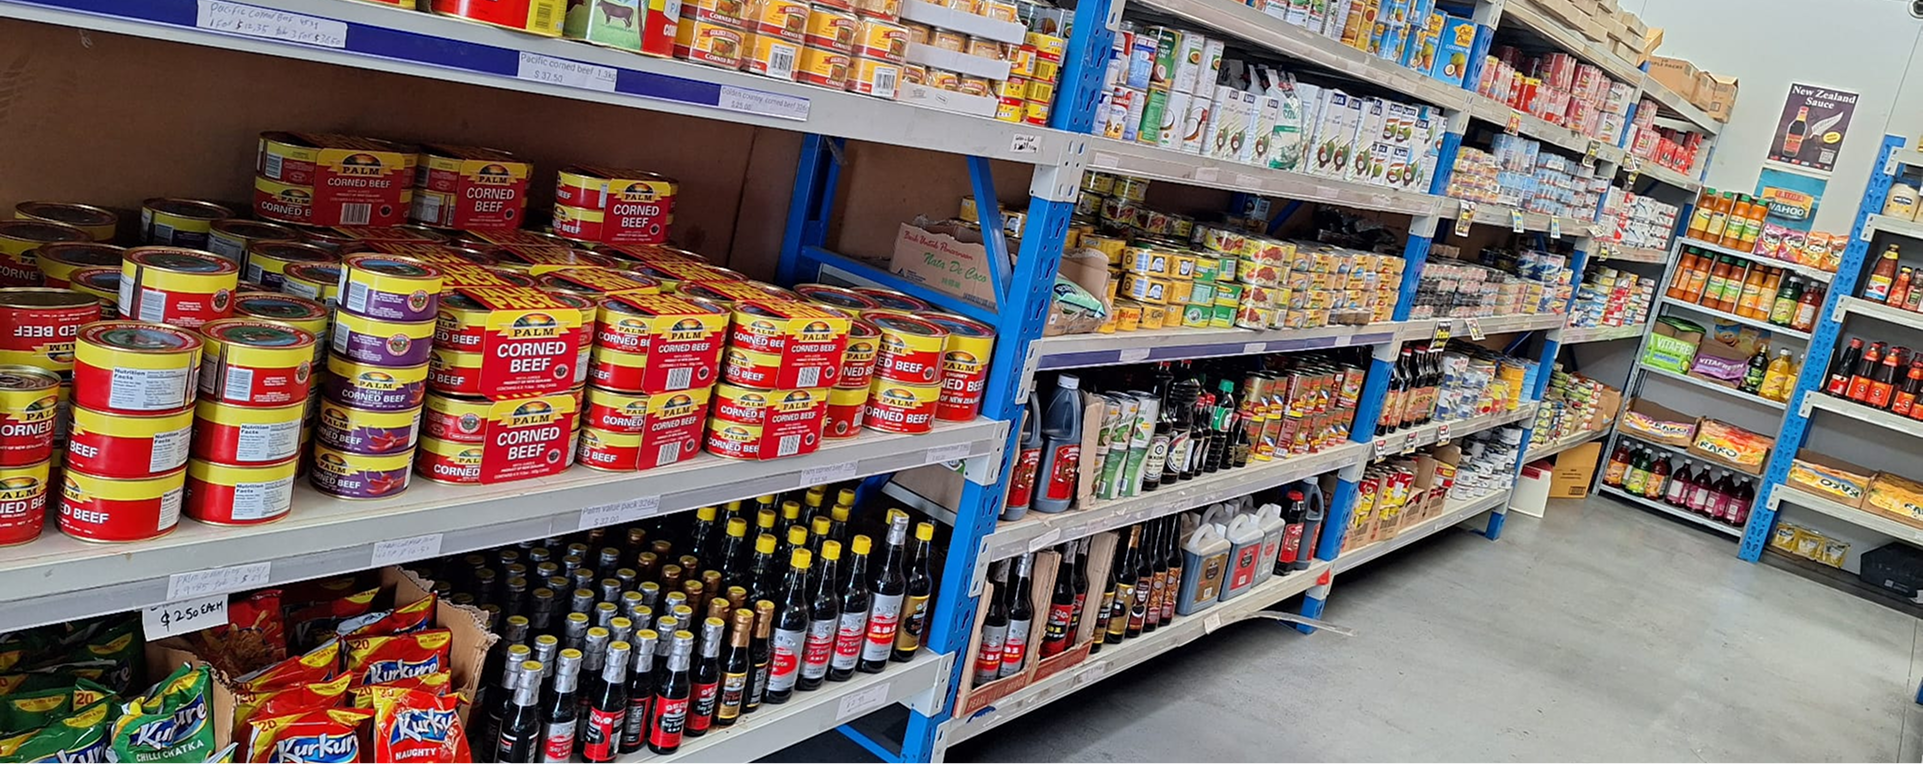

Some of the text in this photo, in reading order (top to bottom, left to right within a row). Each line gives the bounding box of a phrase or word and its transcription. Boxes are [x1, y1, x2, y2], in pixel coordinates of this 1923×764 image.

[520, 53, 548, 66] Pacific
[549, 59, 576, 72] corned
[576, 63, 594, 76] beef
[541, 72, 563, 83] 37.50
[722, 87, 742, 98] Golden
[1792, 85, 1856, 104] New Zealand
[1805, 97, 1834, 109] Sauce
[342, 166, 380, 175] PALM
[327, 177, 392, 189] CORNED BEEF
[466, 188, 515, 200] CORNED
[624, 193, 653, 202] PALM
[261, 201, 302, 216] CORNED
[474, 201, 503, 213] BEEF
[613, 204, 660, 216] CORNED
[621, 217, 650, 228] BEEF
[562, 224, 582, 234] BEEF
[924, 252, 946, 270] Nata
[964, 267, 987, 282] Coco
[14, 325, 54, 337] BEEF
[138, 324, 176, 335] ZEALAND
[514, 329, 554, 337] PALM
[452, 334, 481, 345] BEEF
[599, 331, 638, 346] CORNED
[734, 331, 768, 346] CORNED
[497, 341, 567, 358] CORNED
[658, 343, 711, 354] CORNED BEEF
[791, 345, 819, 353] CORNED
[510, 358, 552, 373] BEEF
[895, 361, 923, 373] BEEF
[943, 363, 976, 372] PALM
[1700, 358, 1744, 370] VITAFRESH
[115, 368, 145, 376] Nutrition
[589, 368, 610, 380] BEEF
[741, 372, 764, 381] BEEF
[360, 381, 392, 389] PALM
[437, 374, 465, 386] BEEF
[341, 389, 406, 403] CORNED BEEF
[783, 401, 810, 410] PALM
[883, 398, 914, 407] PALM
[663, 406, 690, 417] PALM
[721, 405, 757, 418] CORNED
[324, 416, 348, 429] PALM
[513, 414, 550, 426] PALM
[603, 415, 644, 427] CORNED
[651, 416, 698, 432] CORNED BEEF
[906, 413, 929, 424] BEEF
[339, 435, 362, 445] BEEF
[497, 426, 560, 446] CORNED
[724, 433, 748, 441] PALM
[70, 440, 98, 458] BEEF
[708, 437, 741, 452] CORNED
[508, 443, 546, 460] BEEF
[592, 450, 617, 462] BEEF
[319, 461, 346, 474] PALM
[434, 464, 480, 477] CORNED
[338, 478, 361, 489] BEEF
[621, 502, 638, 511] pack
[73, 508, 110, 524] BEEF
[161, 601, 223, 632] $ 2.50 EACH
[353, 639, 370, 650] 20
[370, 660, 438, 684] Kurkure
[358, 687, 372, 697] 20
[76, 693, 94, 704] 20
[259, 720, 277, 732] 20
[136, 740, 205, 762] CHILLI CHATKA
[396, 748, 436, 760] NAUGHTY
